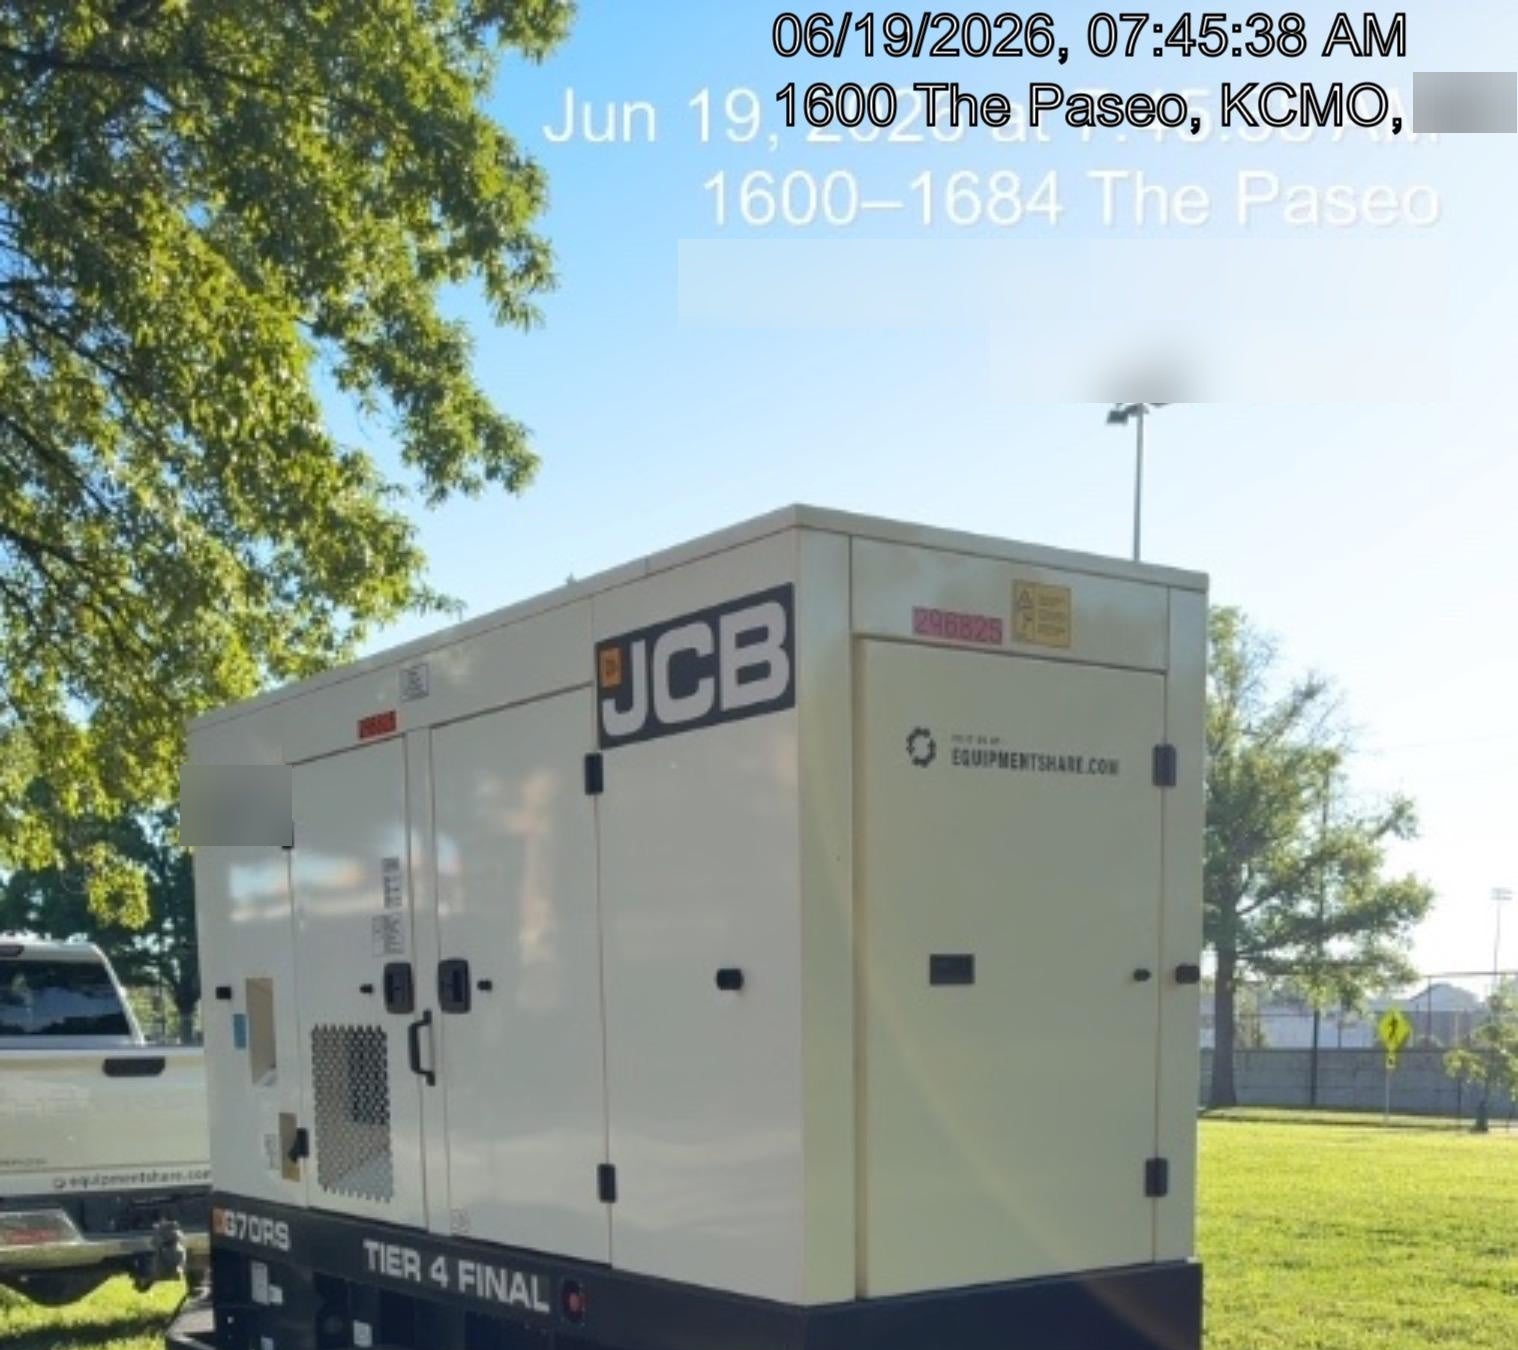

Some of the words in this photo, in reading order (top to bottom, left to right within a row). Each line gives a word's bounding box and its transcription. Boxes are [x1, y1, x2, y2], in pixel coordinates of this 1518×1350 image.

[602, 600, 790, 737] JCB
[363, 1239, 421, 1283] TIER
[430, 1255, 449, 1288] 4
[458, 1259, 550, 1313] FINAL
